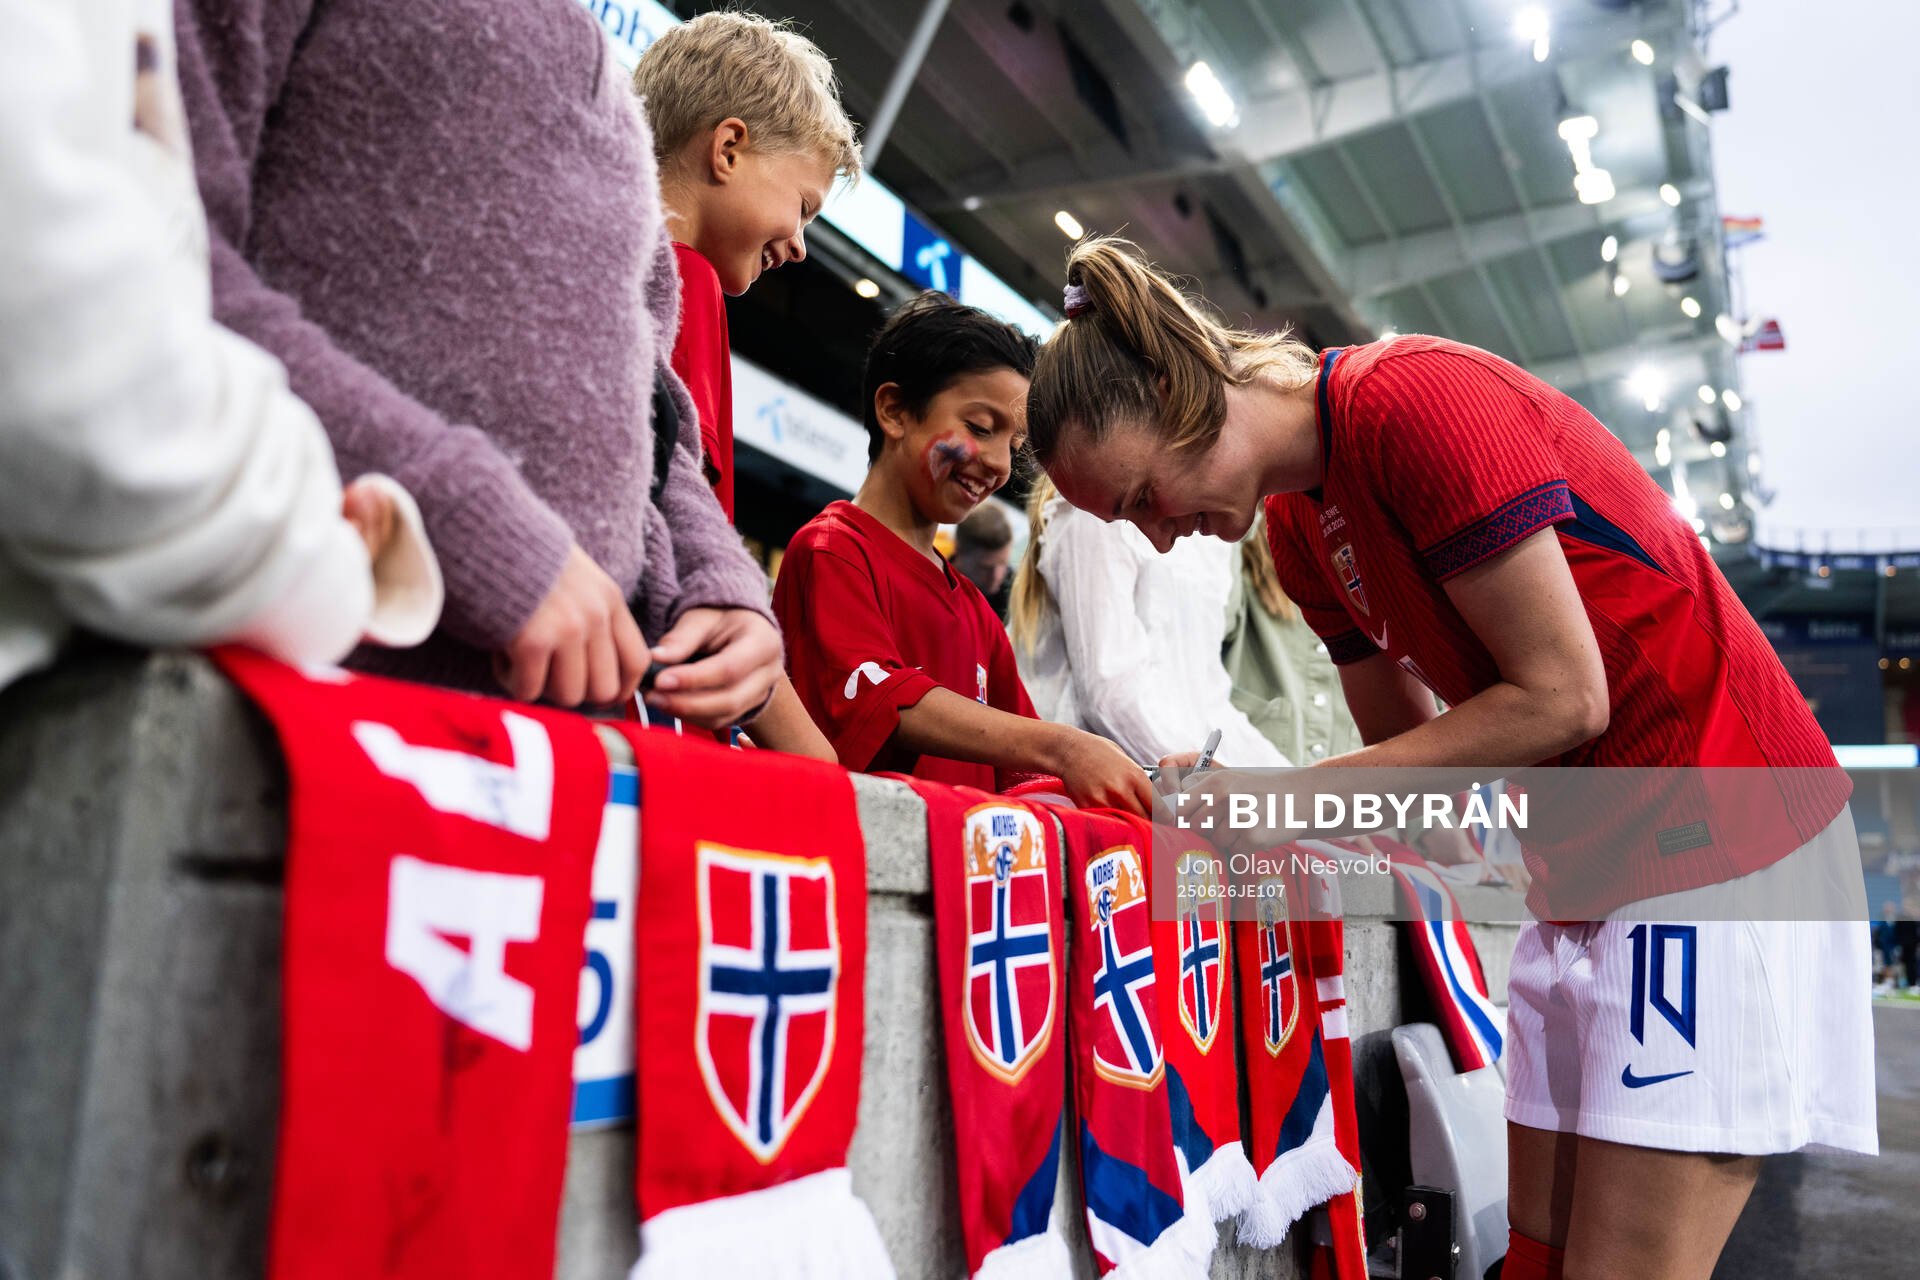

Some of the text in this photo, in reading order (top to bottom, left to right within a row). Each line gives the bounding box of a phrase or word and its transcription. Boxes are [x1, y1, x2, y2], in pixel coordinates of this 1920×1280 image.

[303, 664, 554, 1053] AL
[1093, 859, 1114, 888] NORGE
[1626, 924, 1697, 1050] 10
